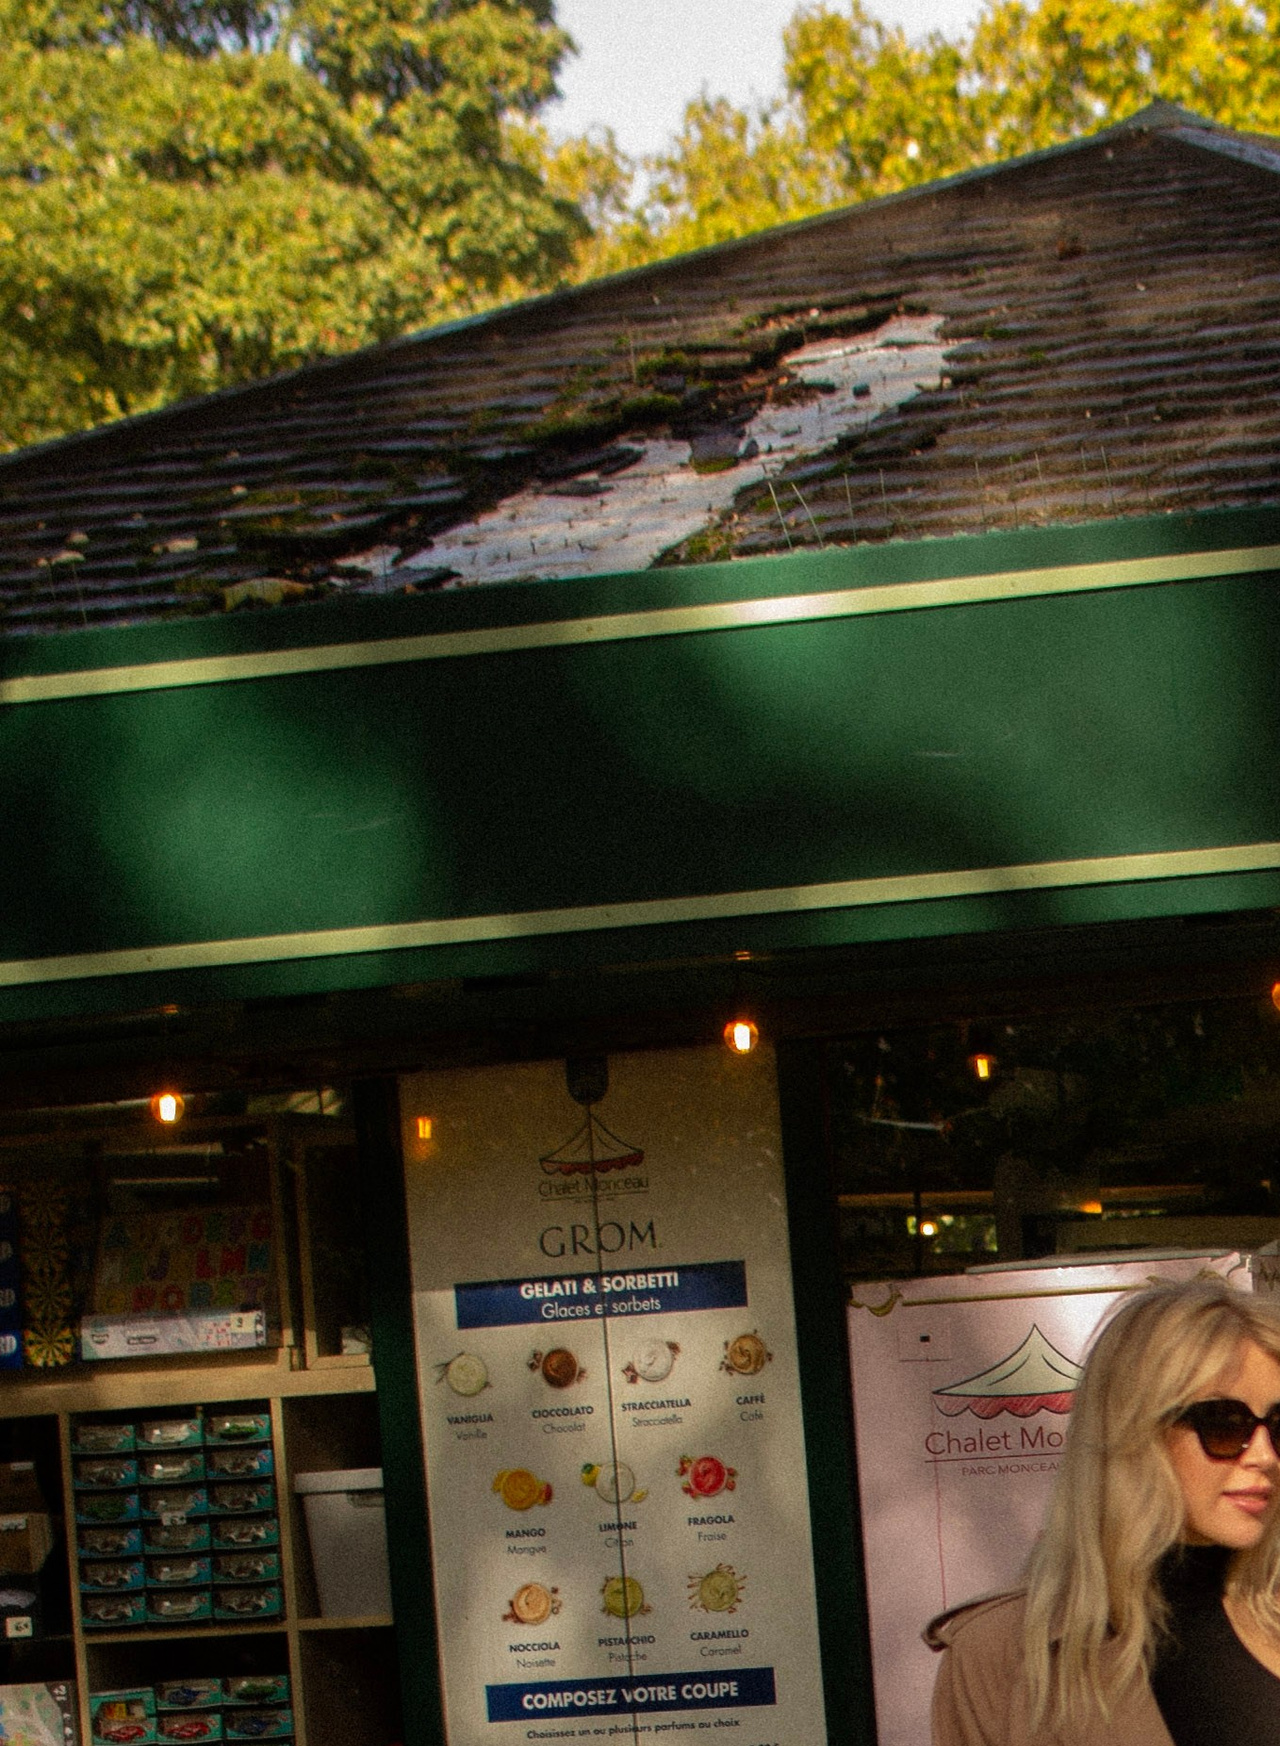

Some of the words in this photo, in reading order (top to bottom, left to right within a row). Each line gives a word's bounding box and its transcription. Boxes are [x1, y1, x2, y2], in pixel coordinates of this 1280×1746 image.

[539, 1181, 580, 1197] Chalet
[540, 1219, 657, 1258] GROM
[521, 1280, 578, 1300] GELATI
[583, 1278, 597, 1294] &
[602, 1272, 679, 1293] SORBETTI
[542, 1302, 590, 1319] Glaces
[612, 1295, 661, 1313] sorbets
[447, 1414, 494, 1425] VANIGLIA
[532, 1405, 594, 1418] CIOCCOLATO
[622, 1398, 692, 1411] STRACCIATELLA
[543, 1422, 586, 1435] Chocolat
[925, 1428, 1012, 1455] Chalet
[1020, 1426, 1064, 1449] Mo
[962, 1465, 995, 1476] PARC
[998, 1462, 1060, 1474] MONCEA
[506, 1528, 545, 1539] MANGO
[599, 1521, 637, 1532] LIMONE
[688, 1514, 735, 1526] FRAGOLA
[508, 1544, 547, 1556] Mangue
[605, 1537, 634, 1548] Cion
[698, 1531, 726, 1542] Fraise
[509, 1641, 560, 1653] NOCCIOLA
[690, 1629, 749, 1641] CARAMELLO
[700, 1645, 741, 1657] Caramel
[522, 1688, 617, 1710] COMPOSEZ
[621, 1685, 677, 1703] VOTRE
[681, 1681, 738, 1700] COUPE
[527, 1729, 575, 1739] Choisissez
[608, 1723, 652, 1736] plusieurs
[655, 1721, 695, 1734] parfums
[713, 1718, 740, 1728] choix
